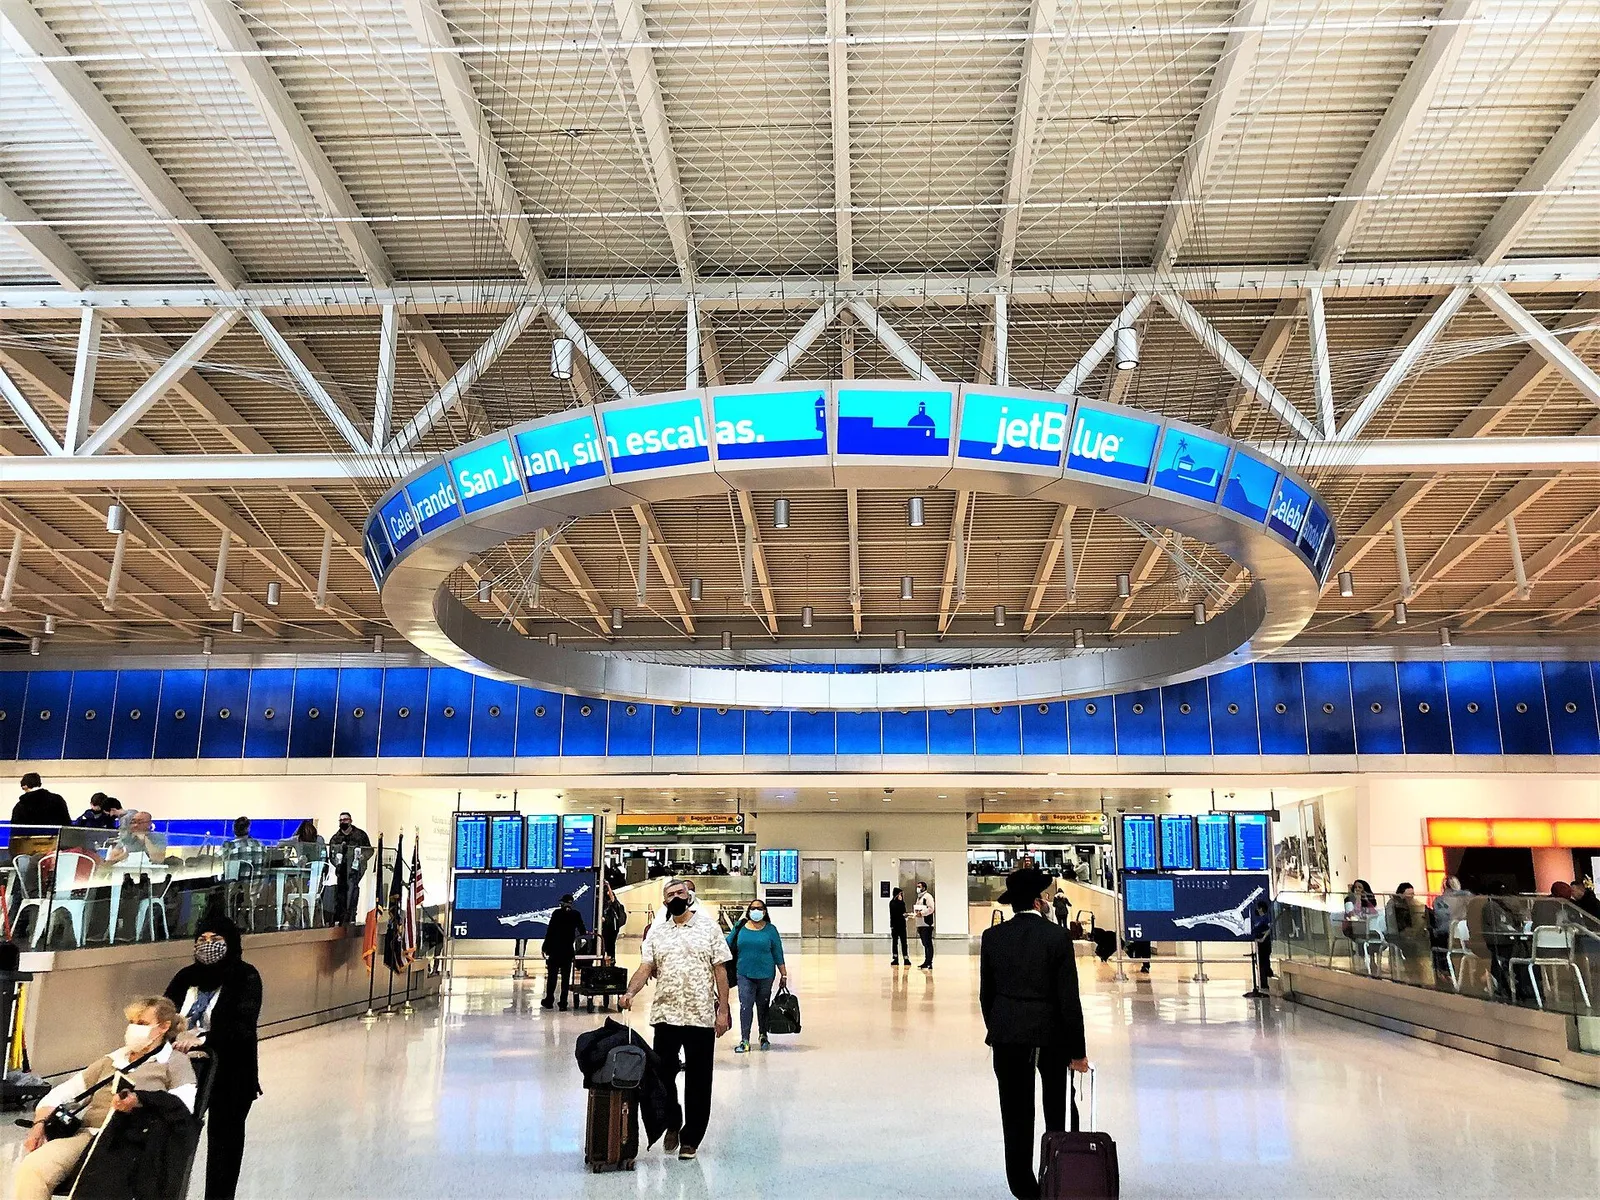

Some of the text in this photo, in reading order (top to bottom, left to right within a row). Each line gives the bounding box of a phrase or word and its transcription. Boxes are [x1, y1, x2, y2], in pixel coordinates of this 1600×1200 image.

[991, 406, 1120, 463] jetBlue
[459, 468, 499, 499] San
[502, 448, 571, 485] Juan,
[573, 433, 619, 466] sin
[626, 415, 765, 455] escalas.
[454, 925, 467, 936] T5
[1128, 927, 1142, 938] T5
